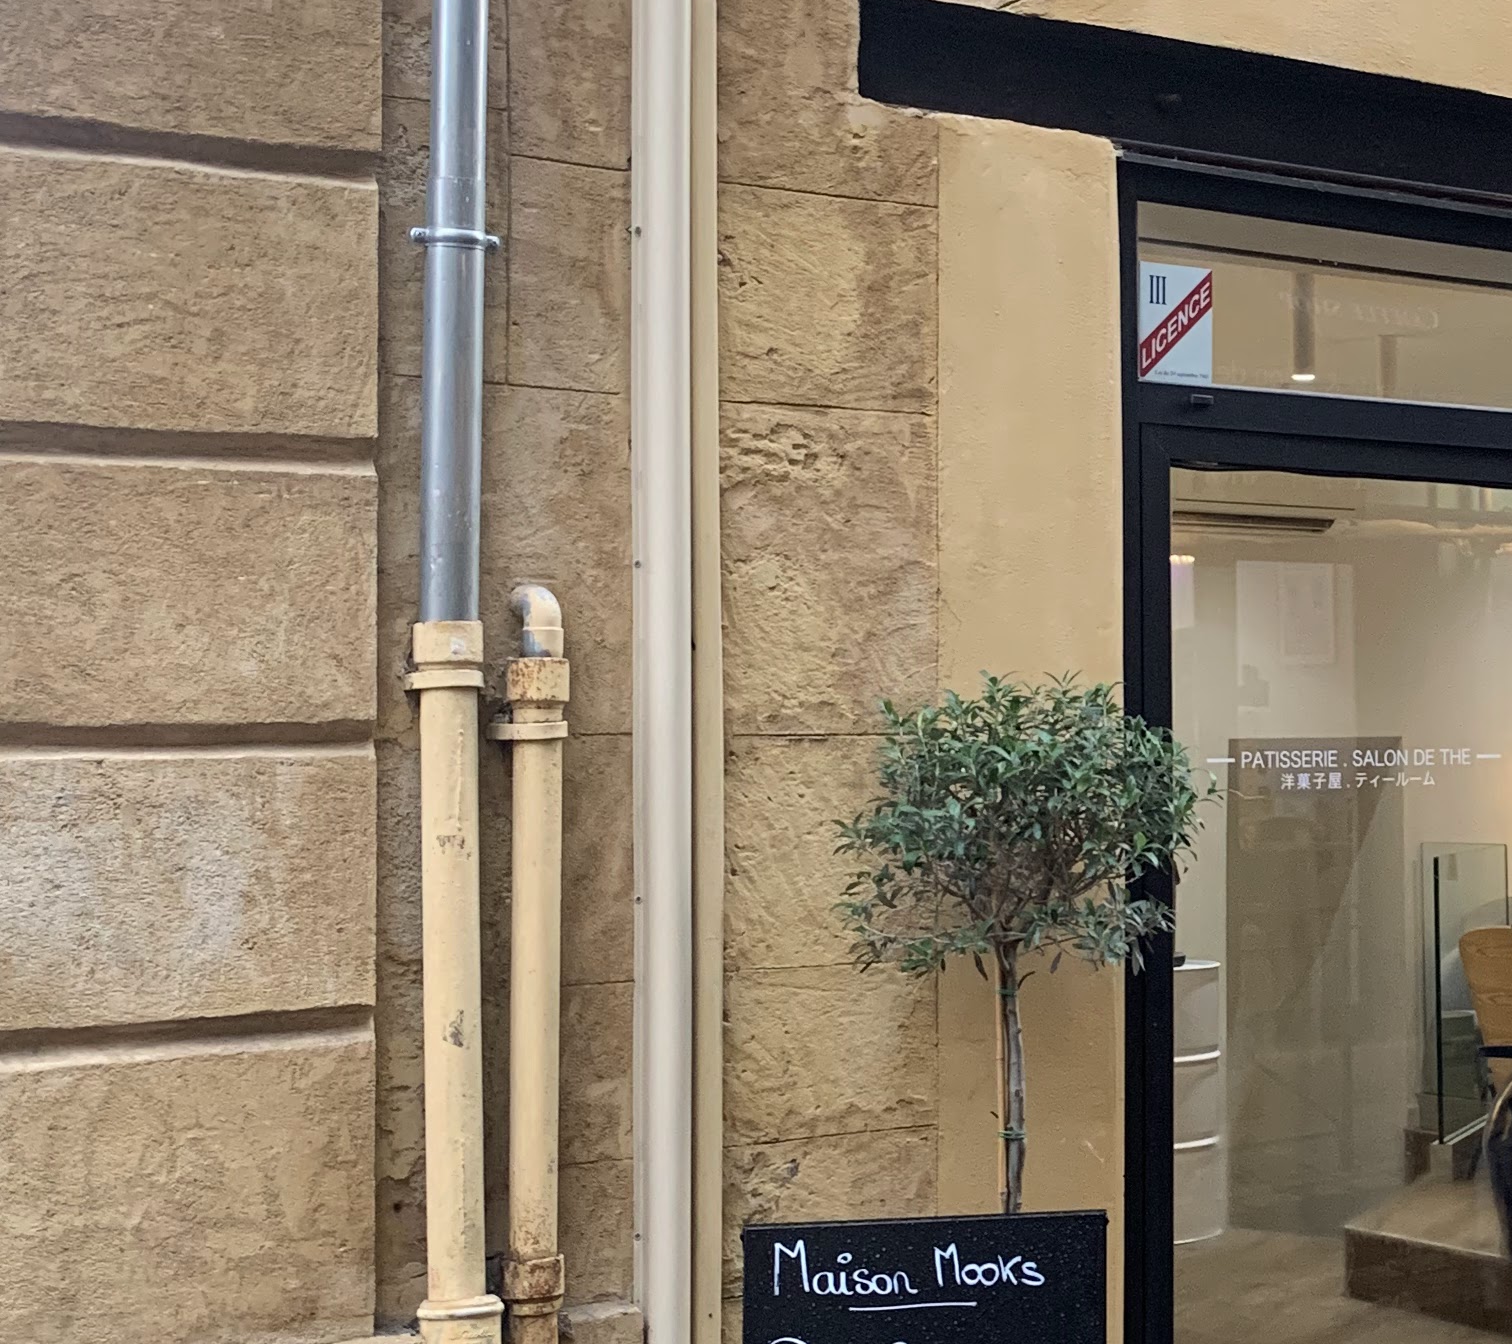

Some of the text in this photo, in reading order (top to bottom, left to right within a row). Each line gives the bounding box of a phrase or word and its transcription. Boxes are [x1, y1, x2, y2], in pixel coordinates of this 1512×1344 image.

[1141, 281, 1211, 369] LICENCE
[1241, 750, 1338, 768] PATISSERIE
[1352, 748, 1408, 767] SALON
[1413, 748, 1435, 766] DE
[1440, 747, 1471, 765] THE
[773, 1239, 918, 1296] Maison
